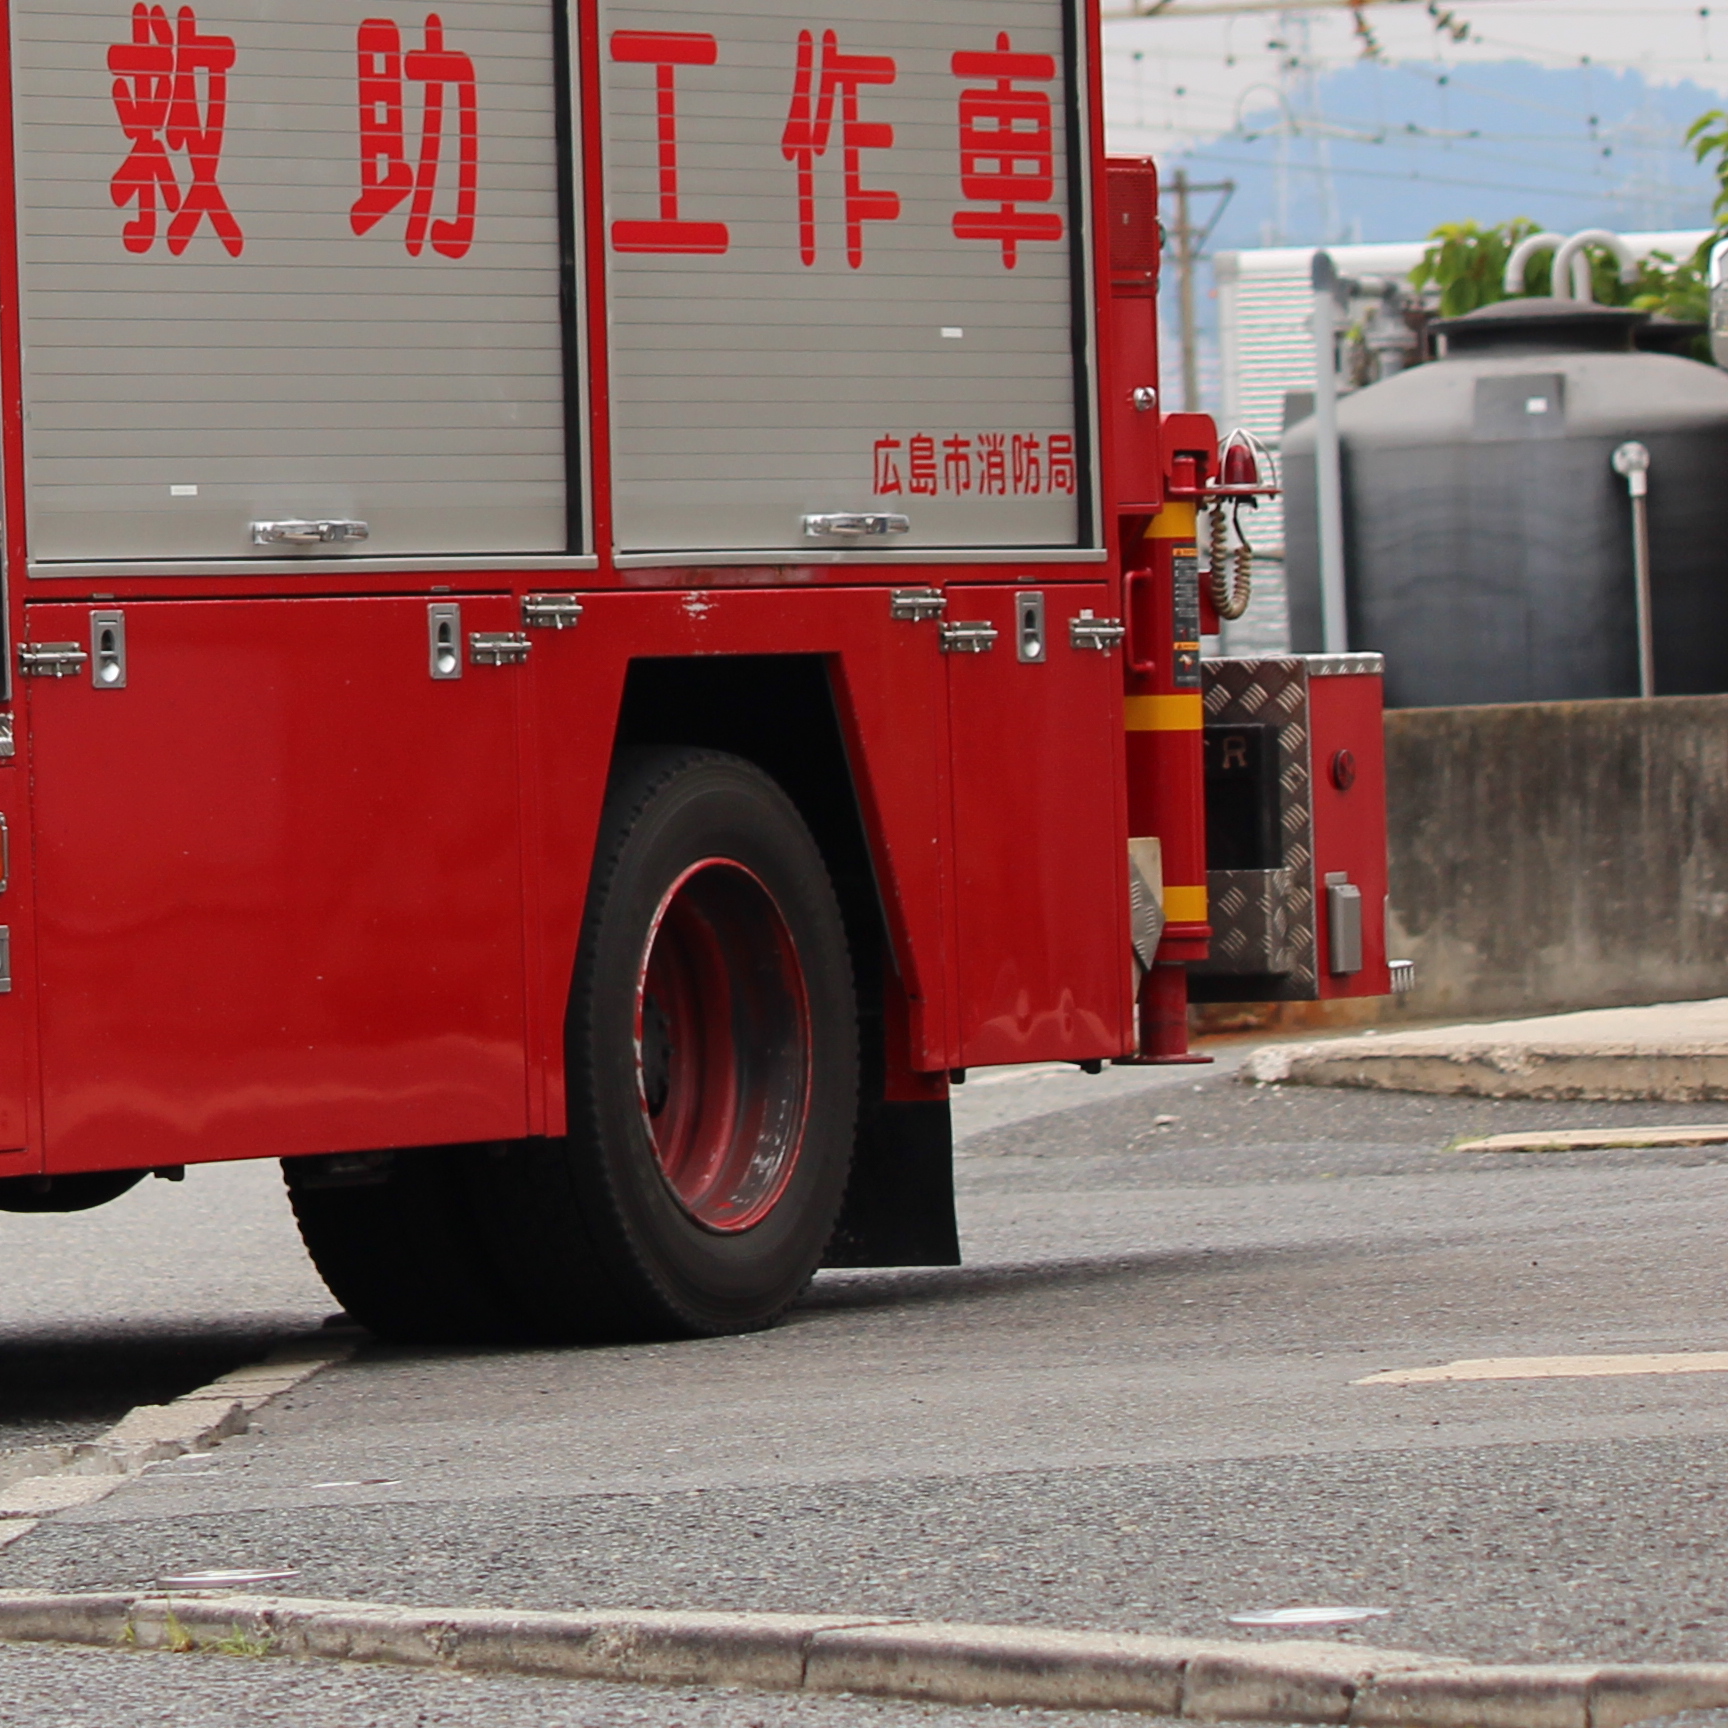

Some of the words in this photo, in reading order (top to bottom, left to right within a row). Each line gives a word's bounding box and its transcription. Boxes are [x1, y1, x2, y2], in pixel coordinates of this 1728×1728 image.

[107, 2, 1062, 269] 救助工作車
[873, 433, 1077, 496] 広島市消防局
